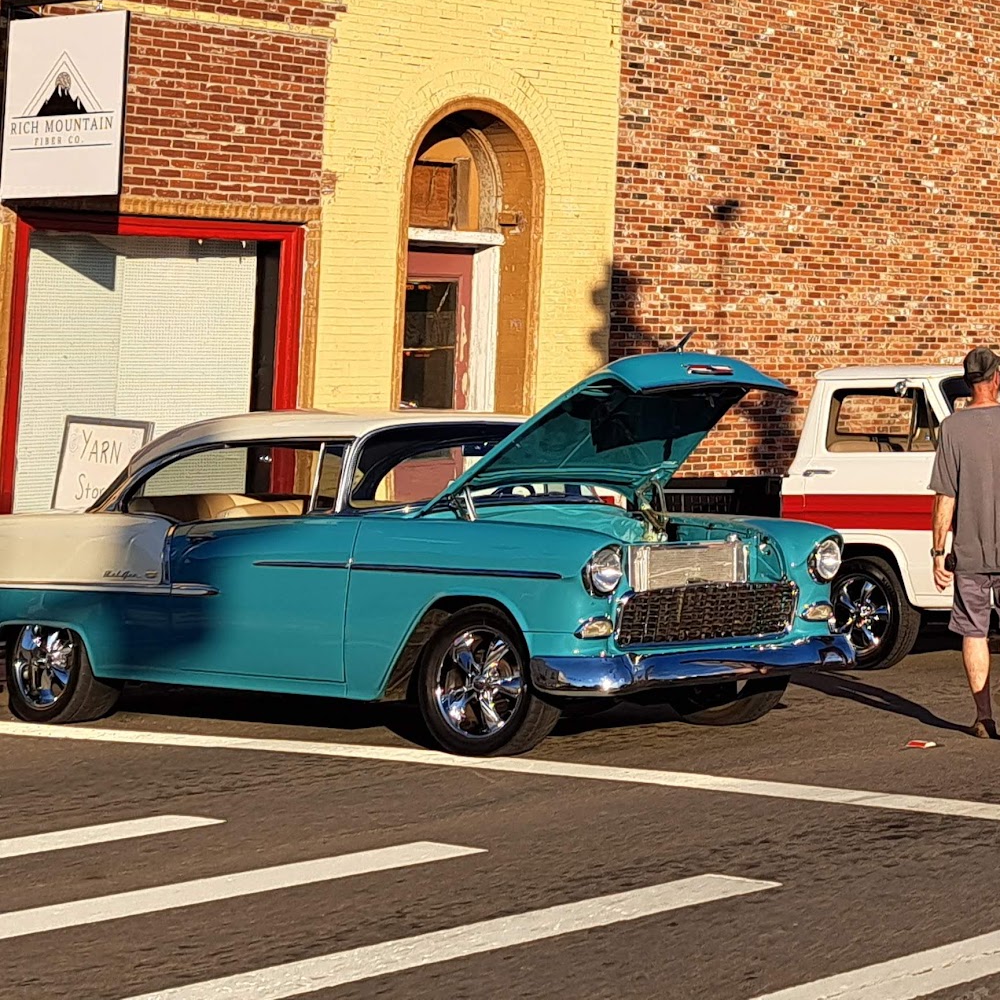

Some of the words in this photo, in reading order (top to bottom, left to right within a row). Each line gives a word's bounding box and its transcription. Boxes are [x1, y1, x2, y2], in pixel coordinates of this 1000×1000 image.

[10, 121, 39, 135] RICH
[45, 116, 114, 133] MOUNTAIN
[34, 136, 62, 146] FIBER
[68, 135, 84, 144] CO.
[80, 429, 122, 464] YARN
[75, 473, 106, 501] Stor
